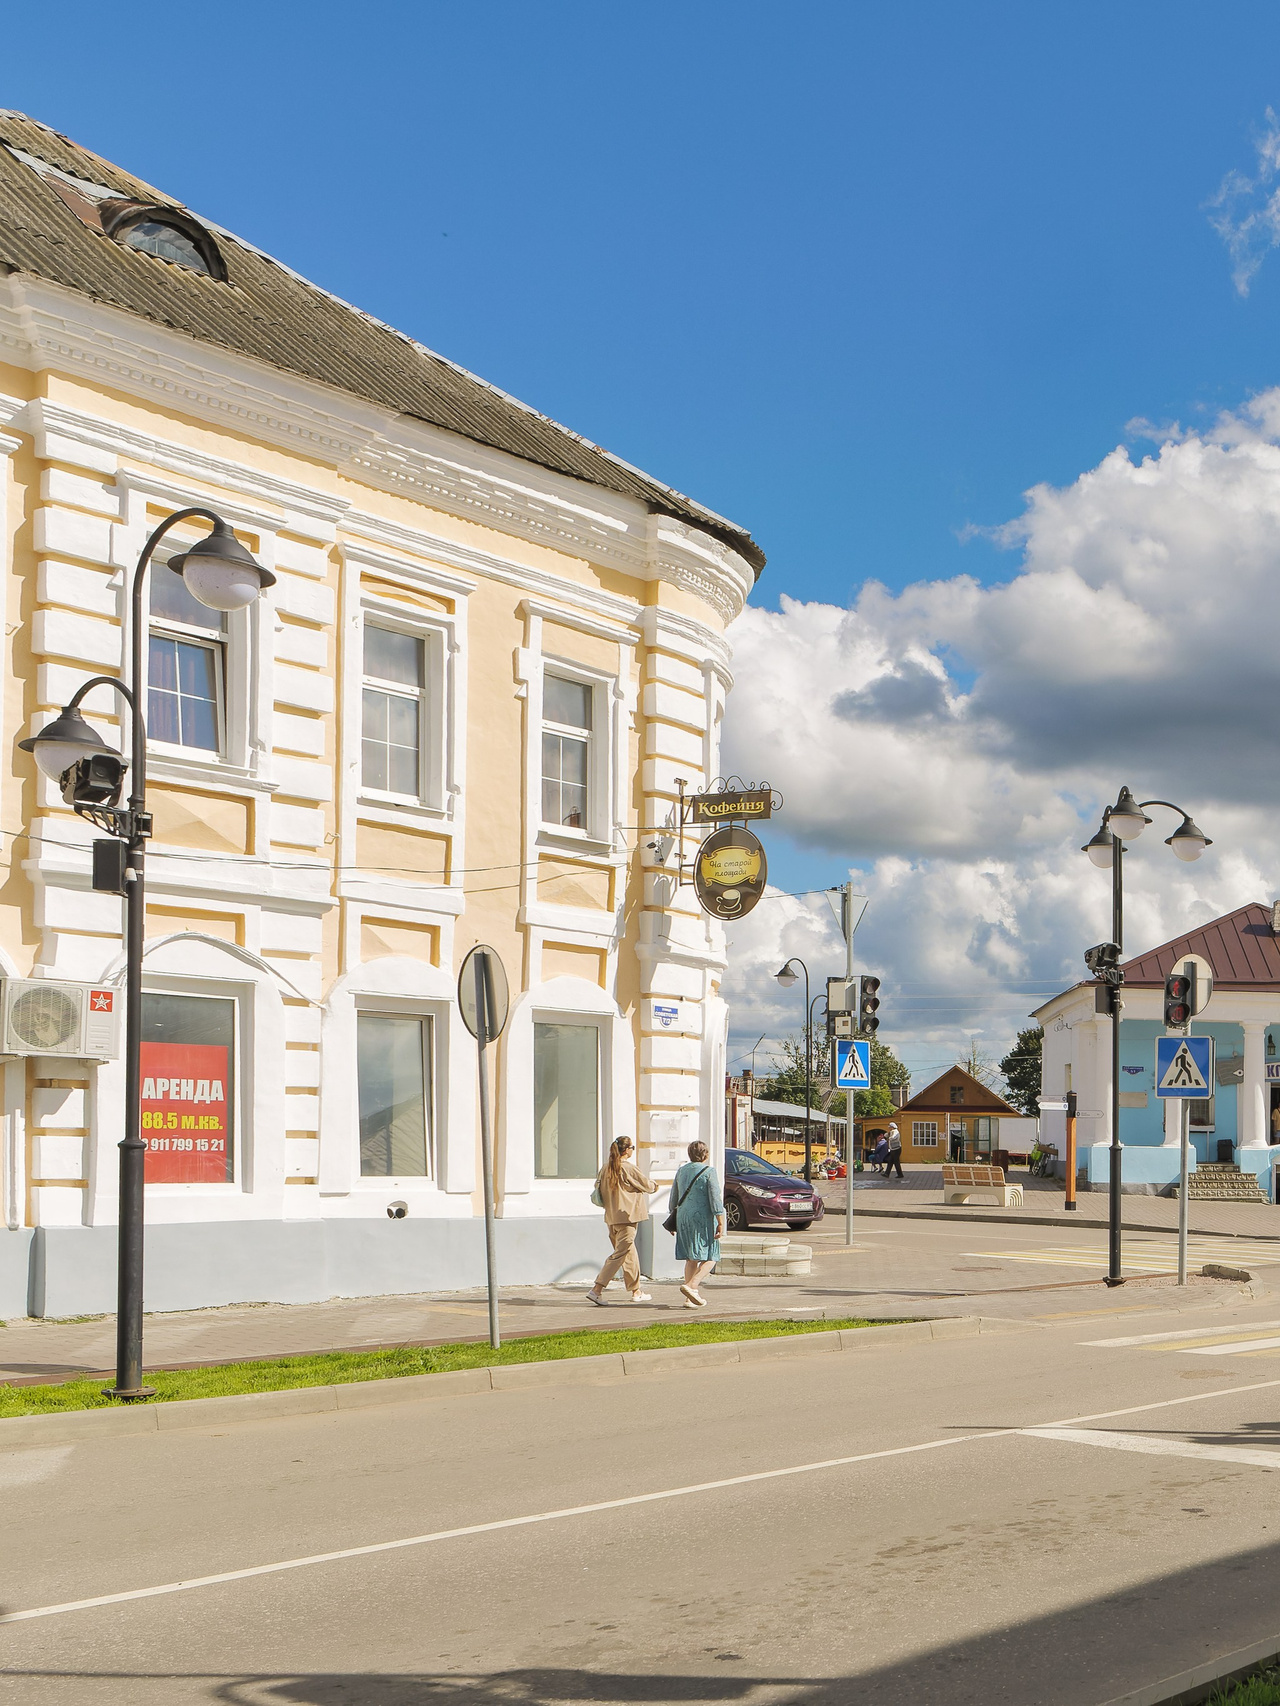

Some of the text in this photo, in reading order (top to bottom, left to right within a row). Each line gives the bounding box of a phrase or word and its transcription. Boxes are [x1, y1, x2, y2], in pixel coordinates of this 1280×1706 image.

[698, 798, 765, 817] Кофейня
[709, 858, 752, 869] На старой
[715, 867, 747, 878] площади
[142, 1077, 224, 1104] АРЕНДА
[142, 1111, 178, 1129] 88.5
[150, 1138, 170, 1151] 911
[171, 1138, 193, 1151] 799
[195, 1138, 209, 1151] 15
[210, 1138, 224, 1151] 21
